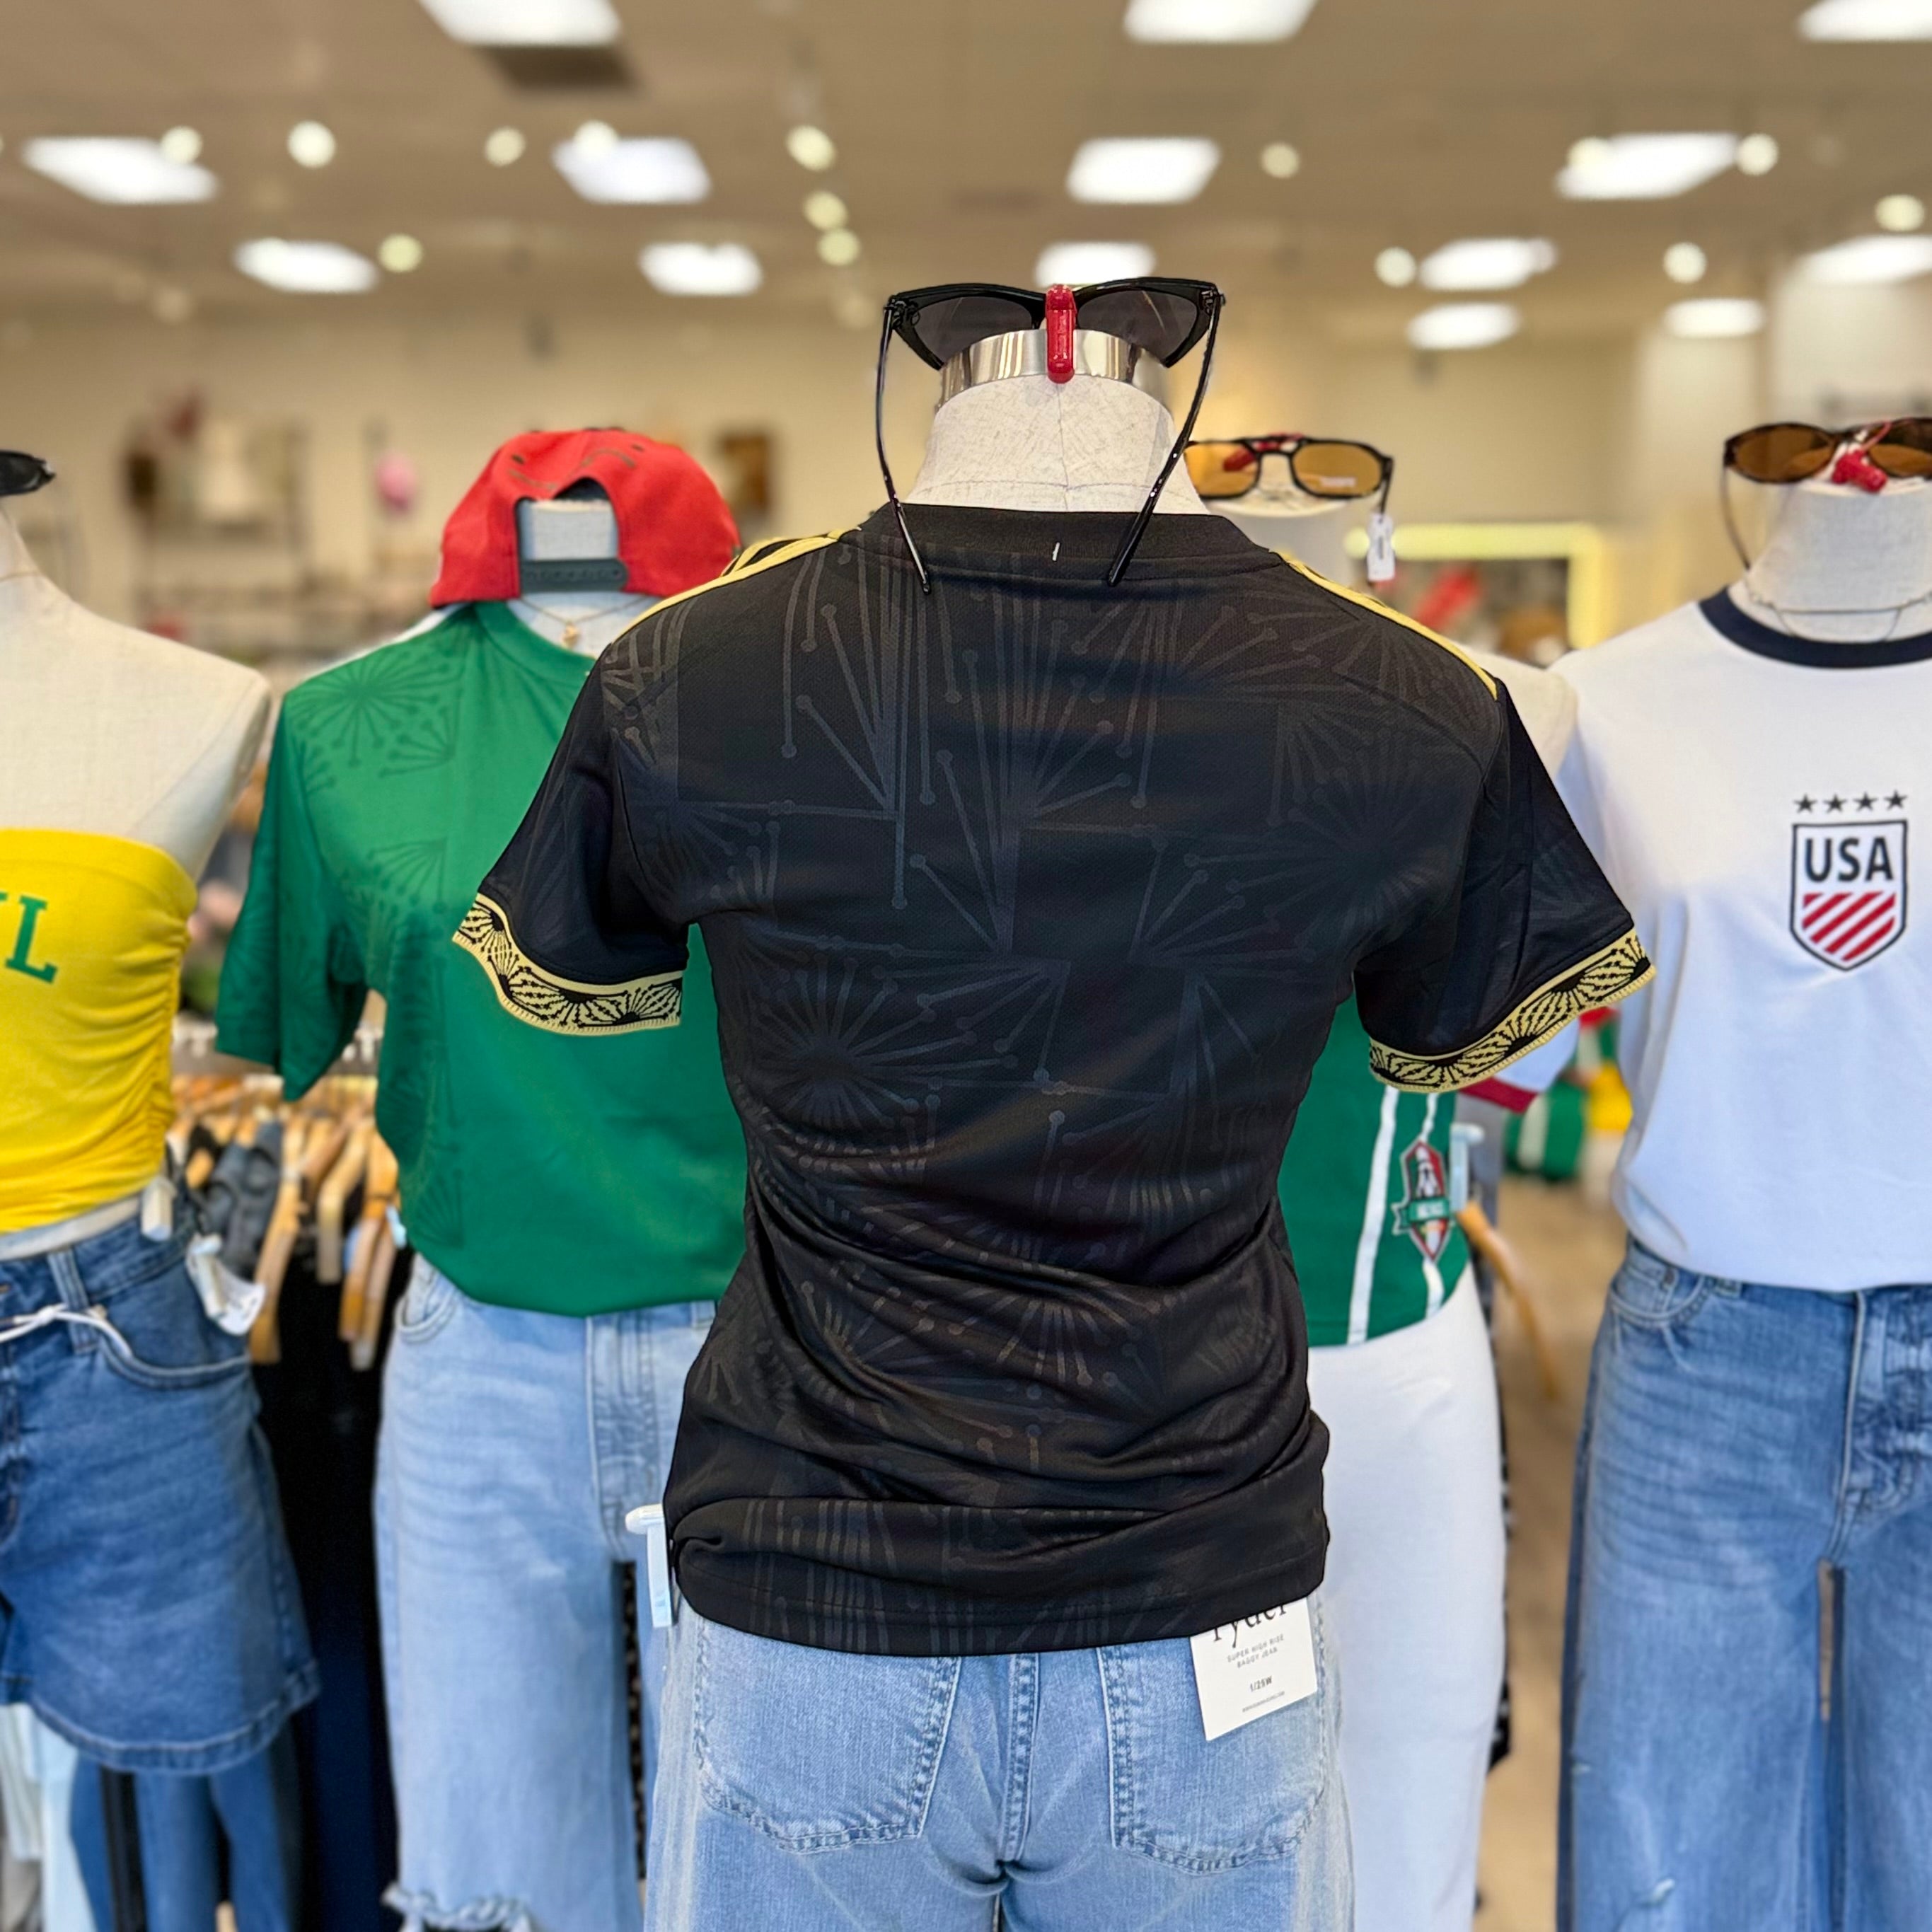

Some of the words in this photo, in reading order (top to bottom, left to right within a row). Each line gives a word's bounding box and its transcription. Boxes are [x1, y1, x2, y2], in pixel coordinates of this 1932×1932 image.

[1805, 836, 1894, 882] USA
[0, 891, 58, 983] L
[1227, 1648, 1249, 1662] SUPER
[1251, 1641, 1267, 1652] HIGH
[1269, 1633, 1284, 1645] RISE
[1237, 1653, 1259, 1668] BAGGY
[1261, 1647, 1278, 1658] JEAN
[1249, 1675, 1272, 1692] 1/25W
